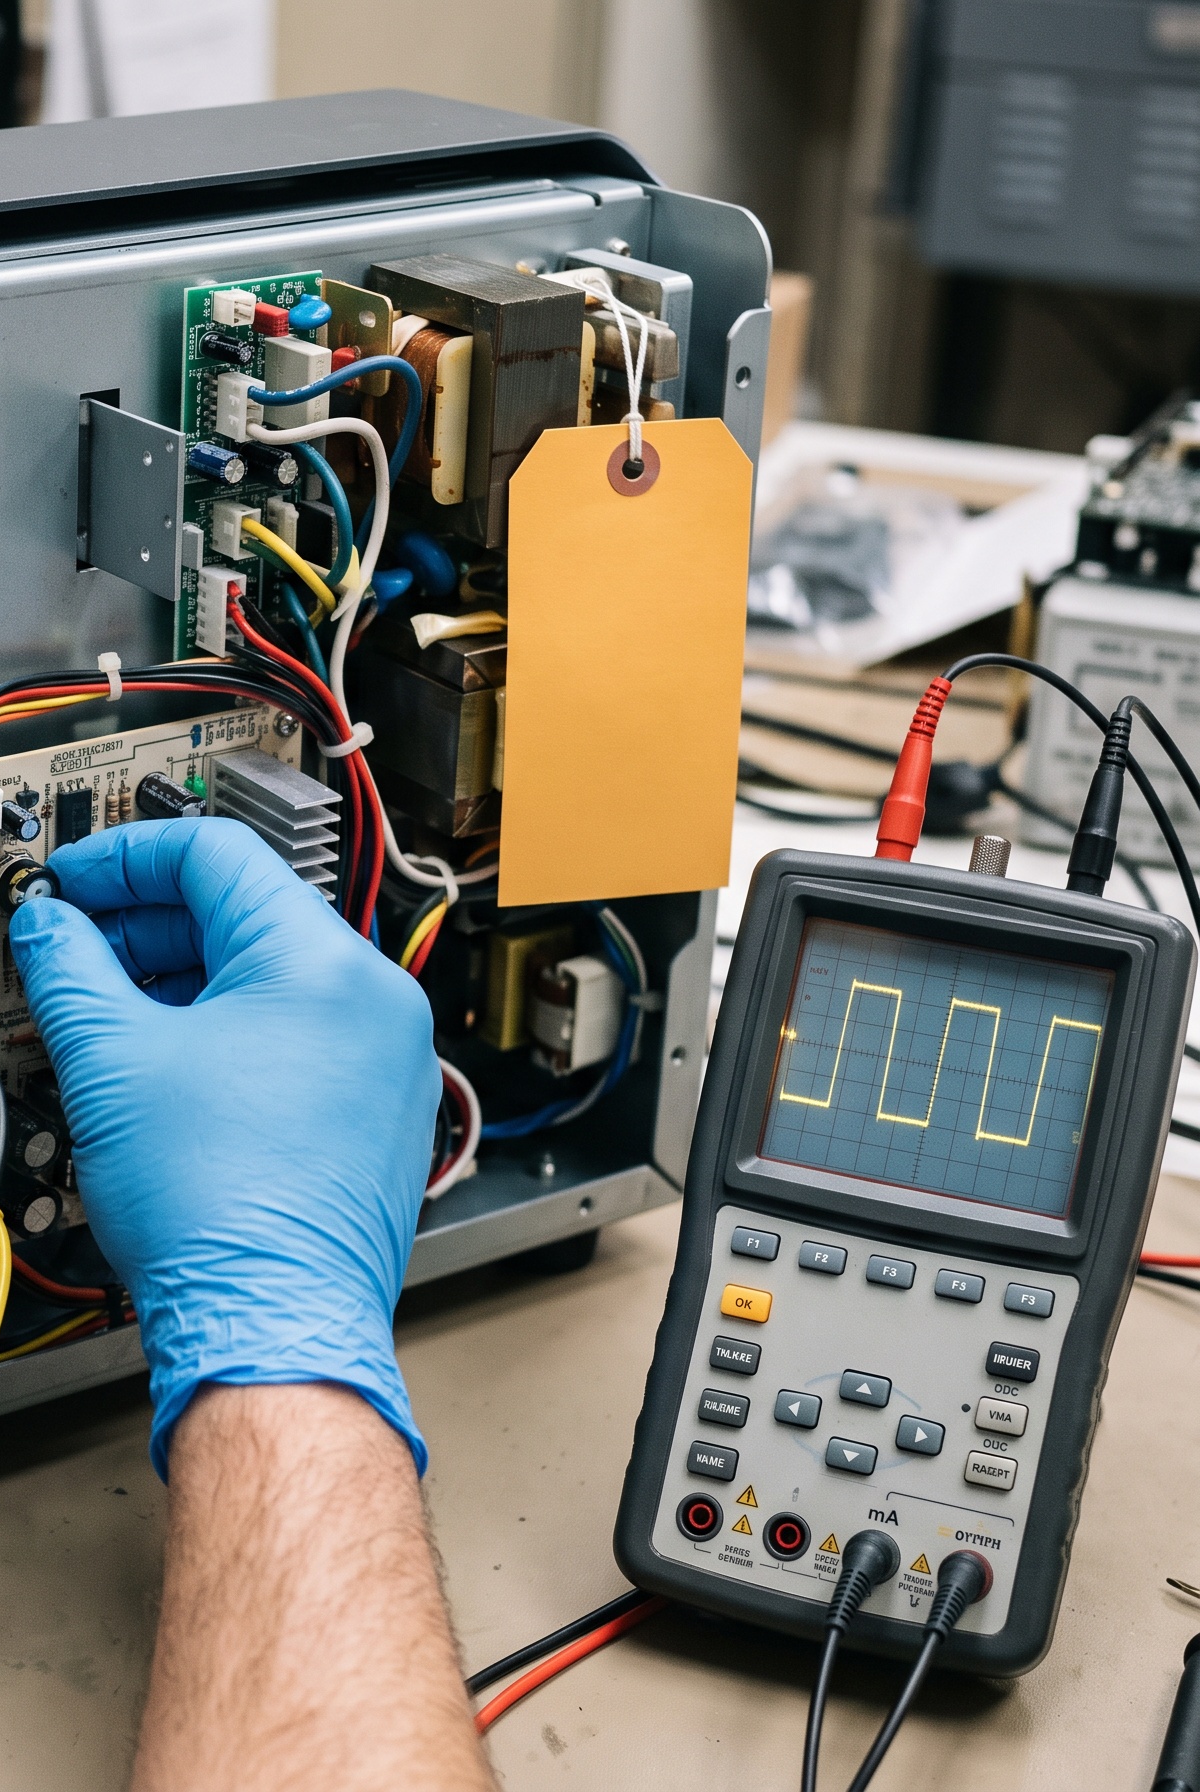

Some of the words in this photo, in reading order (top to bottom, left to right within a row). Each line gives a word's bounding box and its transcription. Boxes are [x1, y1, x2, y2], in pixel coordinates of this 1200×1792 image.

[747, 1237, 760, 1250] F1
[814, 1252, 828, 1264] F2
[735, 1297, 753, 1310] OK
[989, 1410, 1012, 1423] VMA
[868, 1508, 899, 1526] mA
